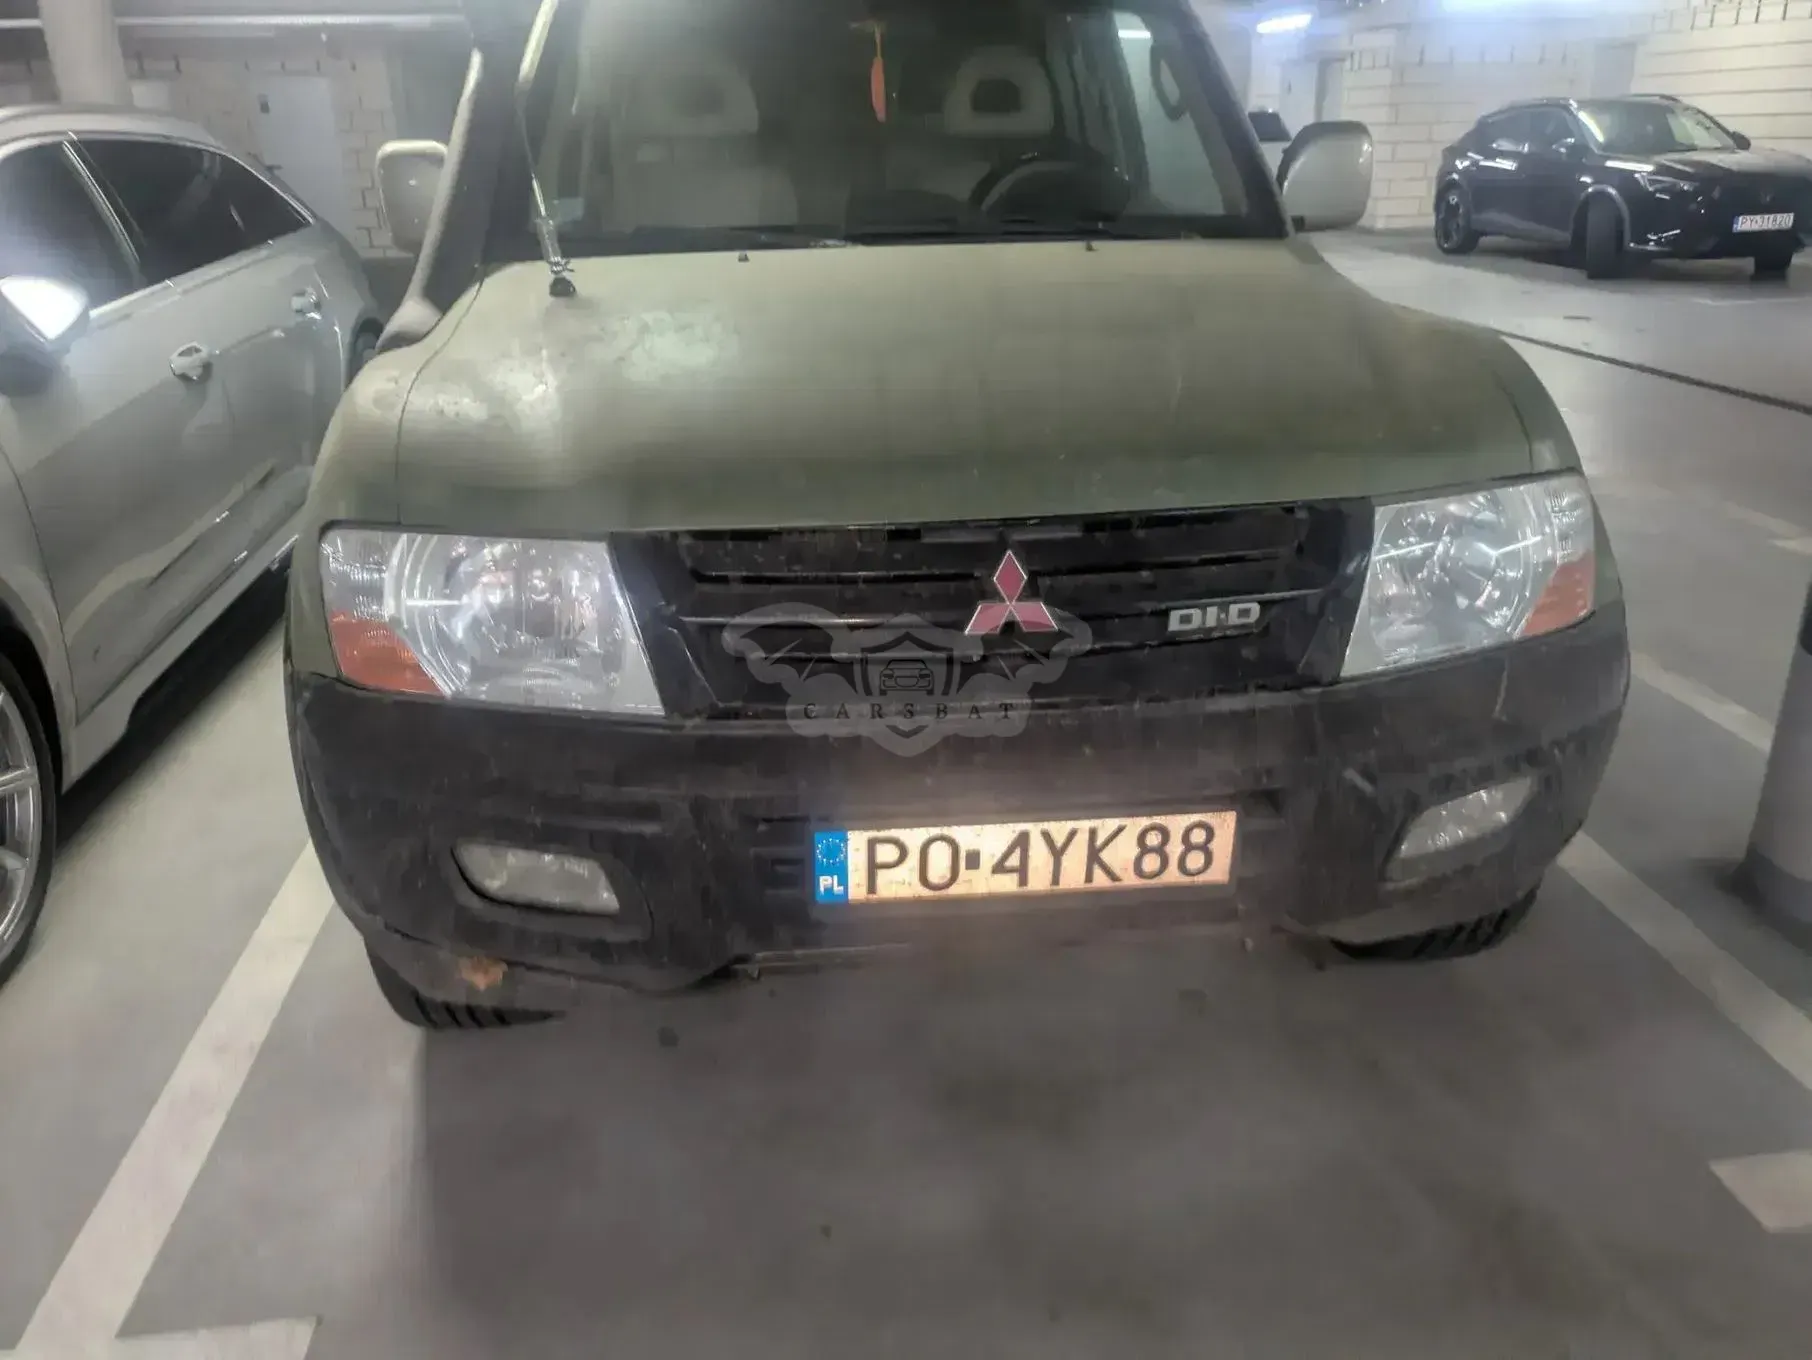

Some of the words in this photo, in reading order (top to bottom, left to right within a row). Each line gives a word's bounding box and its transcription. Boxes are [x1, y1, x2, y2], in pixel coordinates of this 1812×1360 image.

[866, 833, 961, 895] PO
[990, 819, 1216, 888] 4YK88
[819, 874, 844, 896] PL
